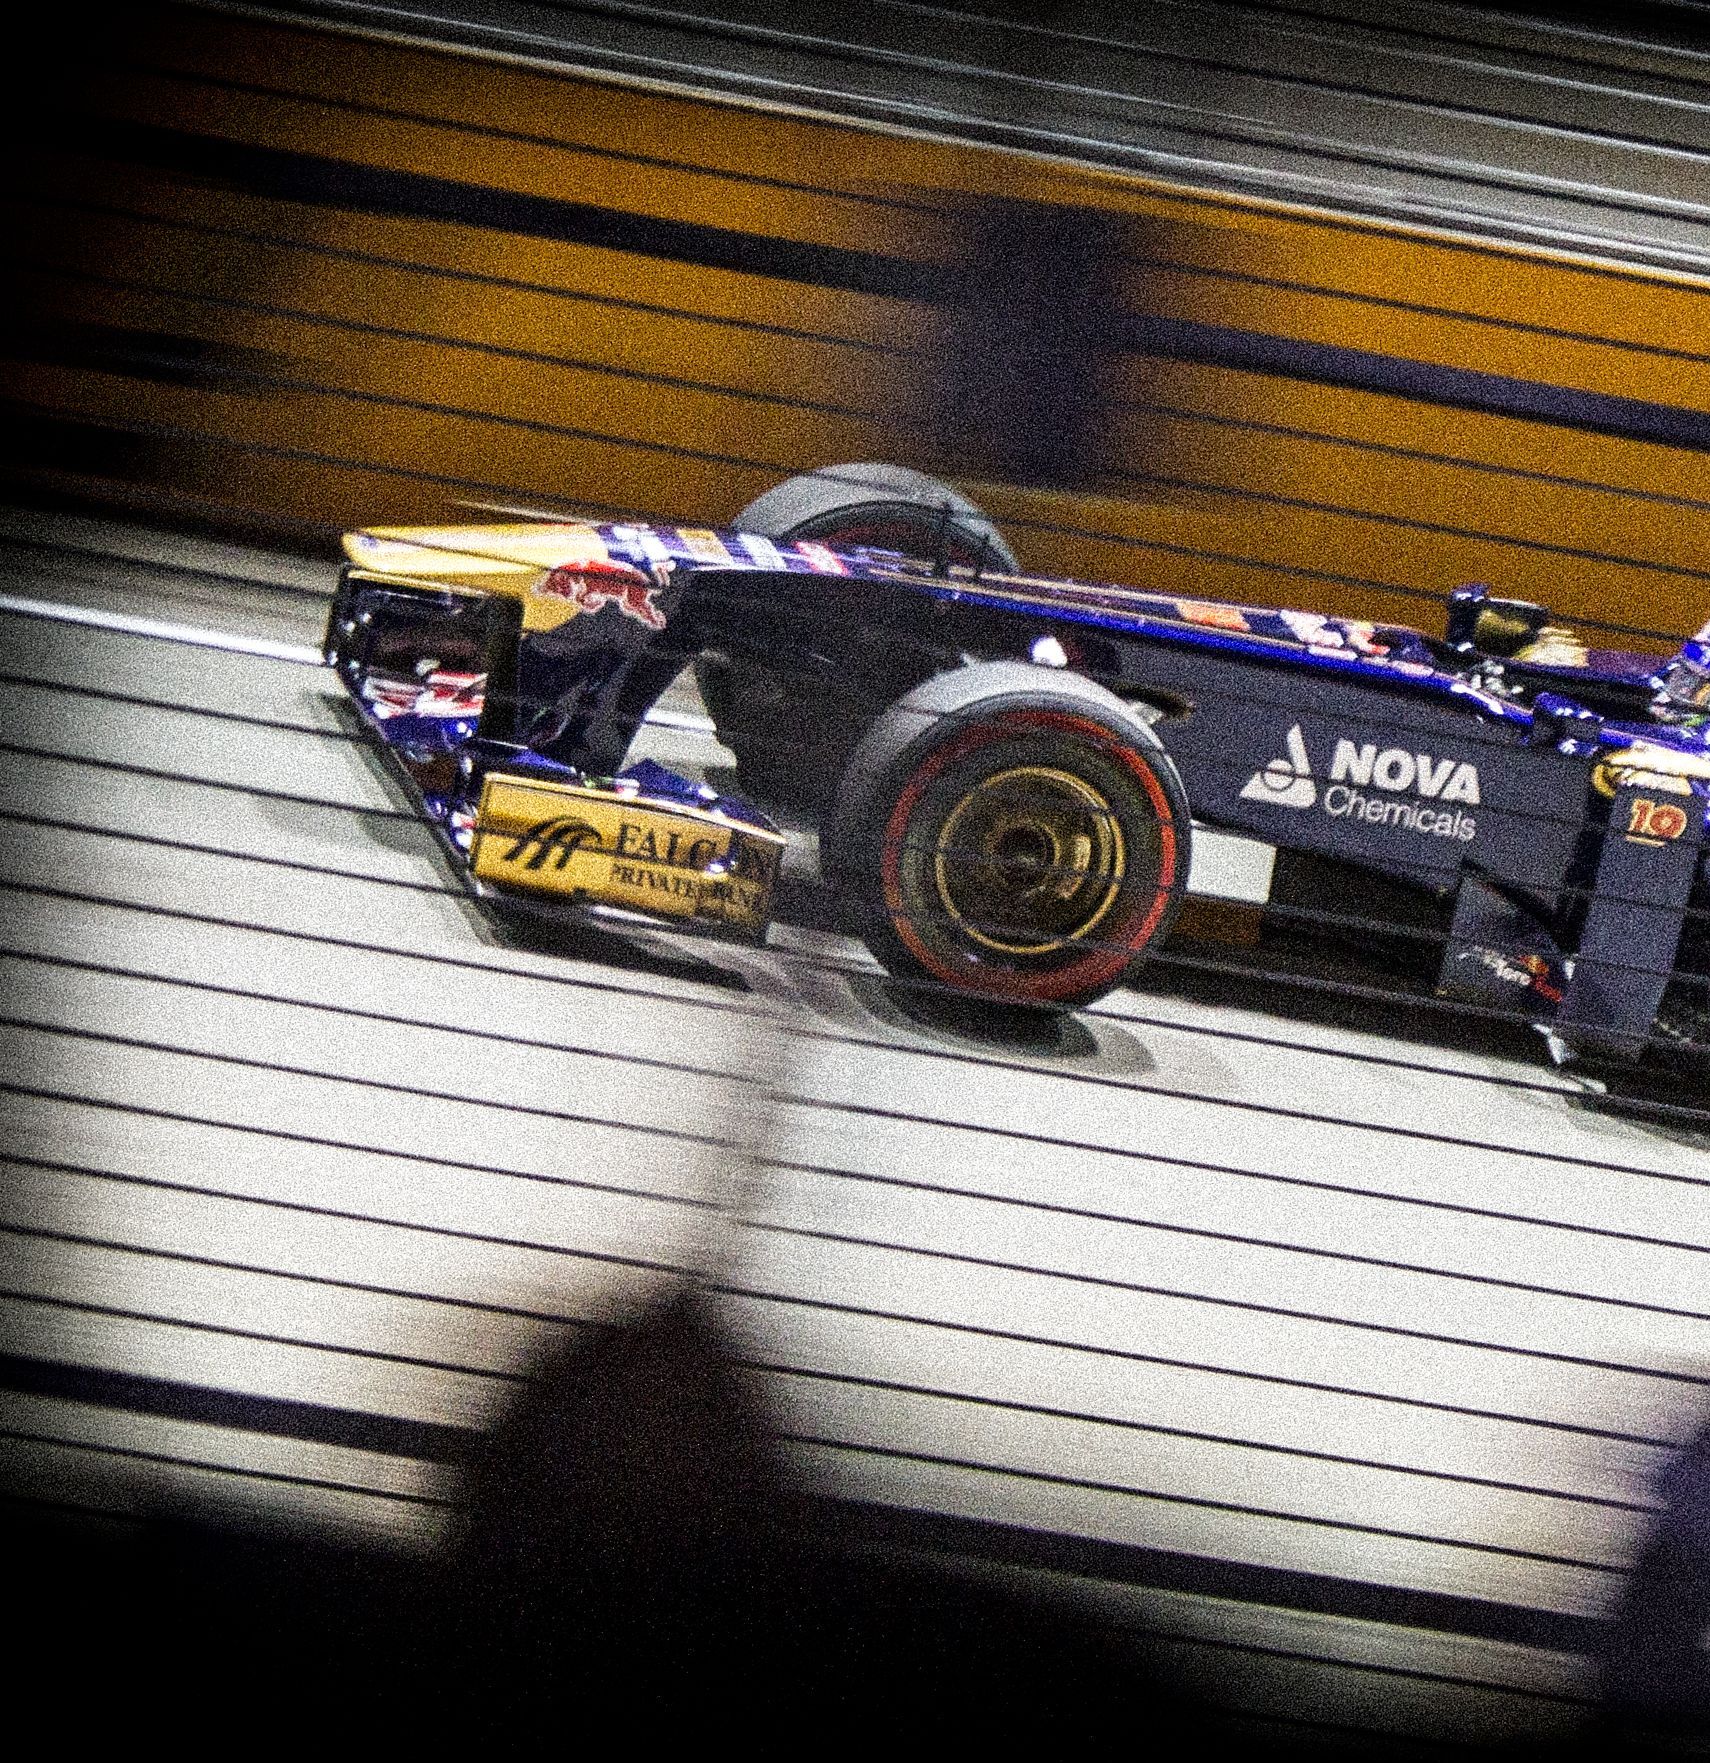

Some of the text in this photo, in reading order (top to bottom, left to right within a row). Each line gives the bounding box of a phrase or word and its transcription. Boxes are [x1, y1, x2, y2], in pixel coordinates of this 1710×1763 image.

[1331, 738, 1481, 804] NOVA
[1324, 785, 1477, 841] Chemicals
[1625, 797, 1697, 848] 10
